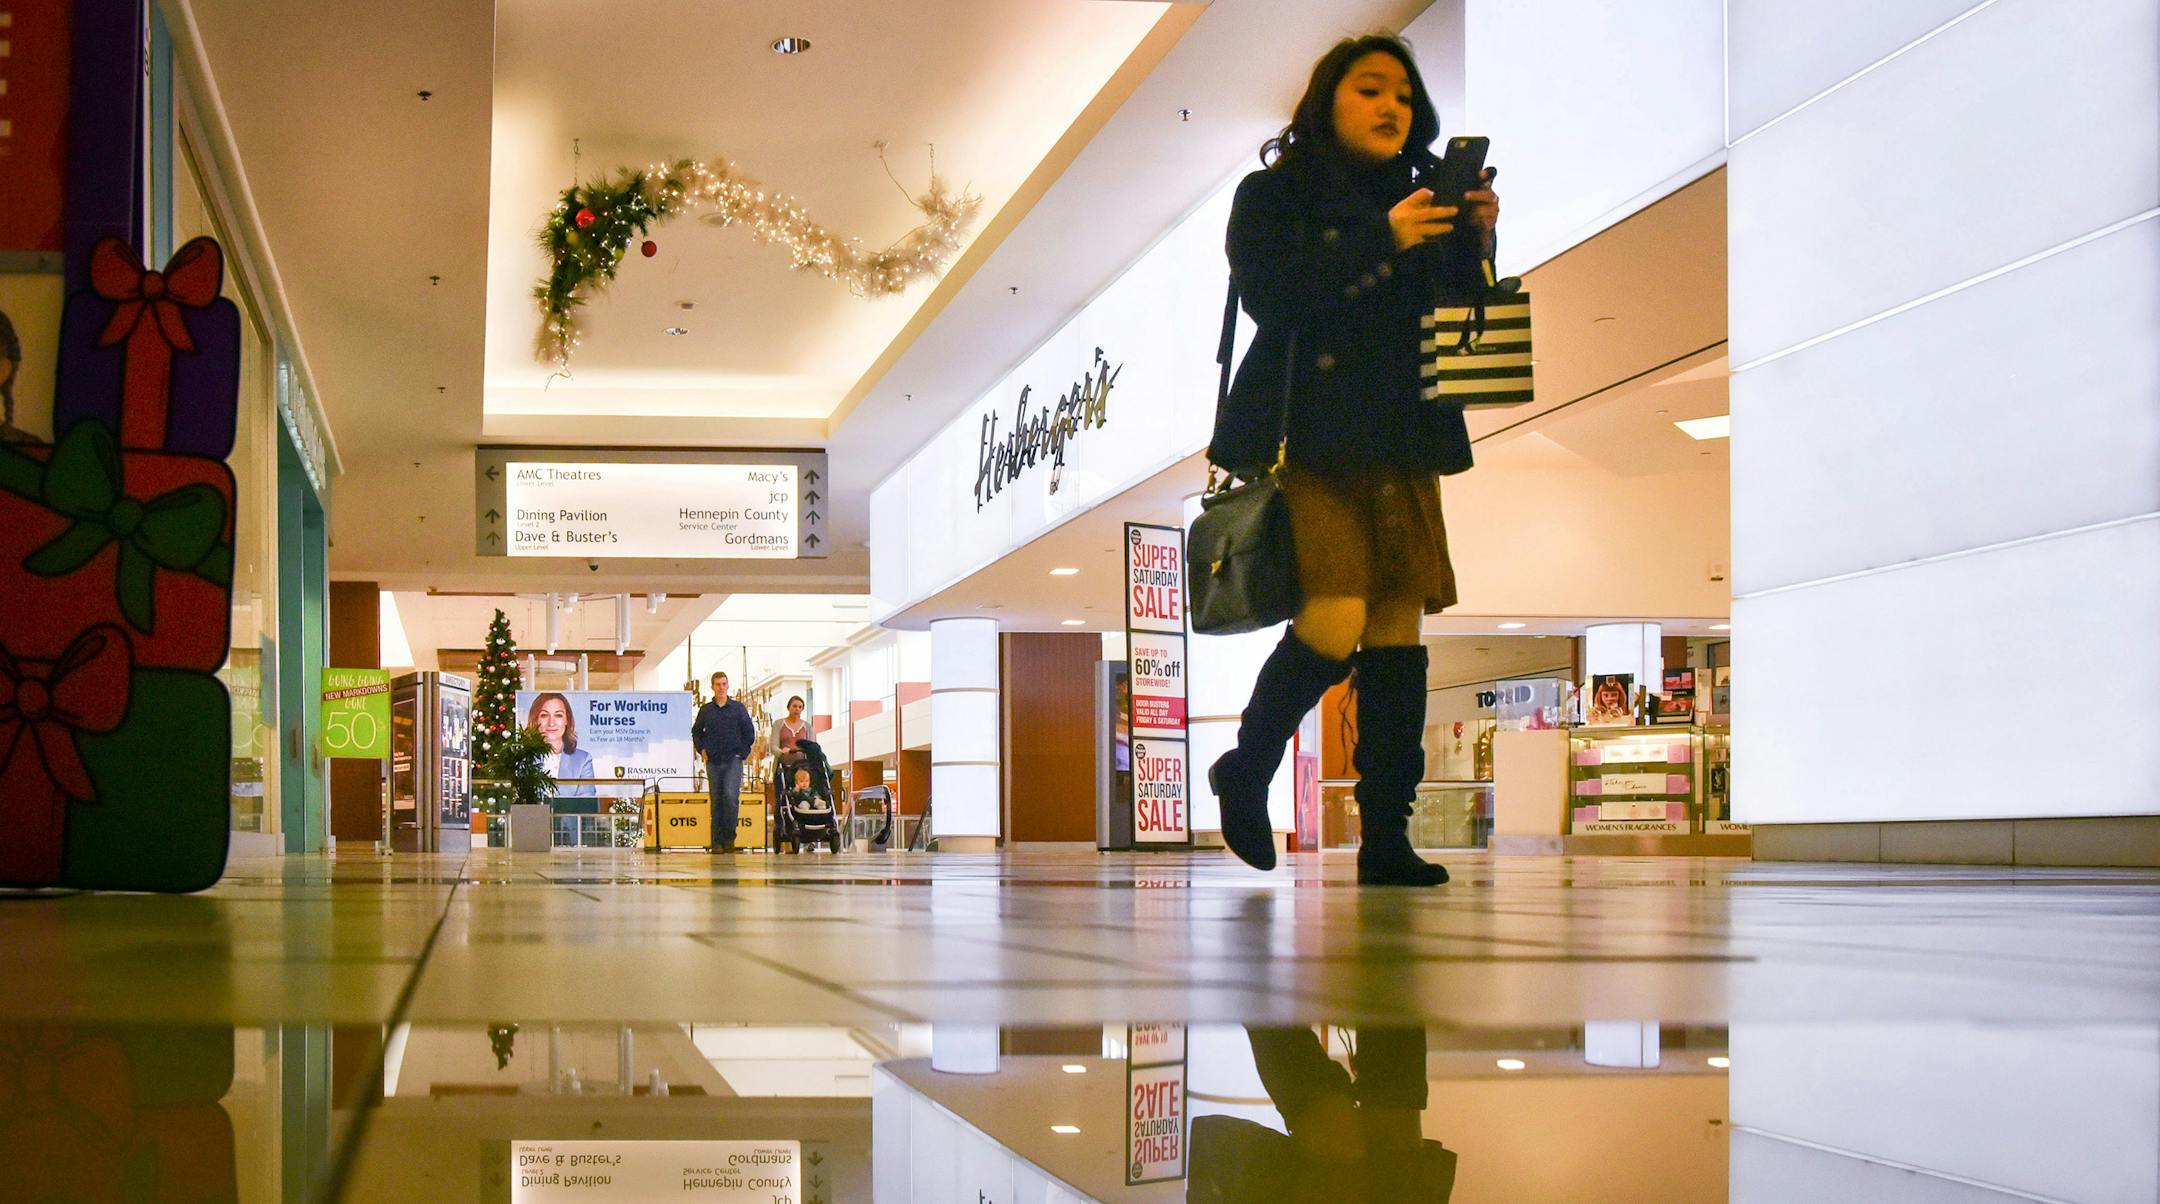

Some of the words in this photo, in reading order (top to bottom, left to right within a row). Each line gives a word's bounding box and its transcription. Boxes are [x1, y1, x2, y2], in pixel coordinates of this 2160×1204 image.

[517, 468, 543, 480] AMC
[547, 468, 602, 480] Theatres
[747, 471, 789, 485] Macy's
[769, 490, 789, 505] jcp
[517, 509, 555, 523] Dining
[559, 509, 607, 521] Pavilion
[679, 507, 739, 522] Hennepin
[744, 508, 789, 523] County
[679, 522, 709, 531] Service
[711, 522, 738, 531] Center
[515, 530, 546, 542] Dave
[551, 530, 561, 542] &
[566, 530, 618, 543] Buster's
[724, 532, 789, 545] Gordmans
[1133, 543, 1178, 571] SUPER
[1133, 568, 1178, 588] SATURDAY
[1133, 585, 1179, 620] SALE
[1134, 647, 1150, 657] SAVE
[1151, 648, 1159, 657] UP
[1160, 649, 1168, 658] TO
[1135, 658, 1163, 677] 60%
[1164, 660, 1181, 678] off
[1135, 677, 1171, 689] STOREWIDE!
[325, 691, 341, 700] NEW
[342, 684, 388, 698] MARKDOWNS
[589, 700, 611, 712] For
[614, 699, 668, 714] Working
[589, 714, 636, 726] Nurses
[326, 711, 377, 750] 50
[627, 767, 677, 775] RASMUSSEN
[1137, 757, 1182, 783] SUPER
[1138, 782, 1183, 799] SATURDAY
[669, 817, 698, 827] OTIS
[736, 817, 753, 827] TIS
[1138, 799, 1183, 832] SALE
[1585, 823, 1624, 832] WOMEN'S
[1625, 823, 1677, 832] FRAGRANCES
